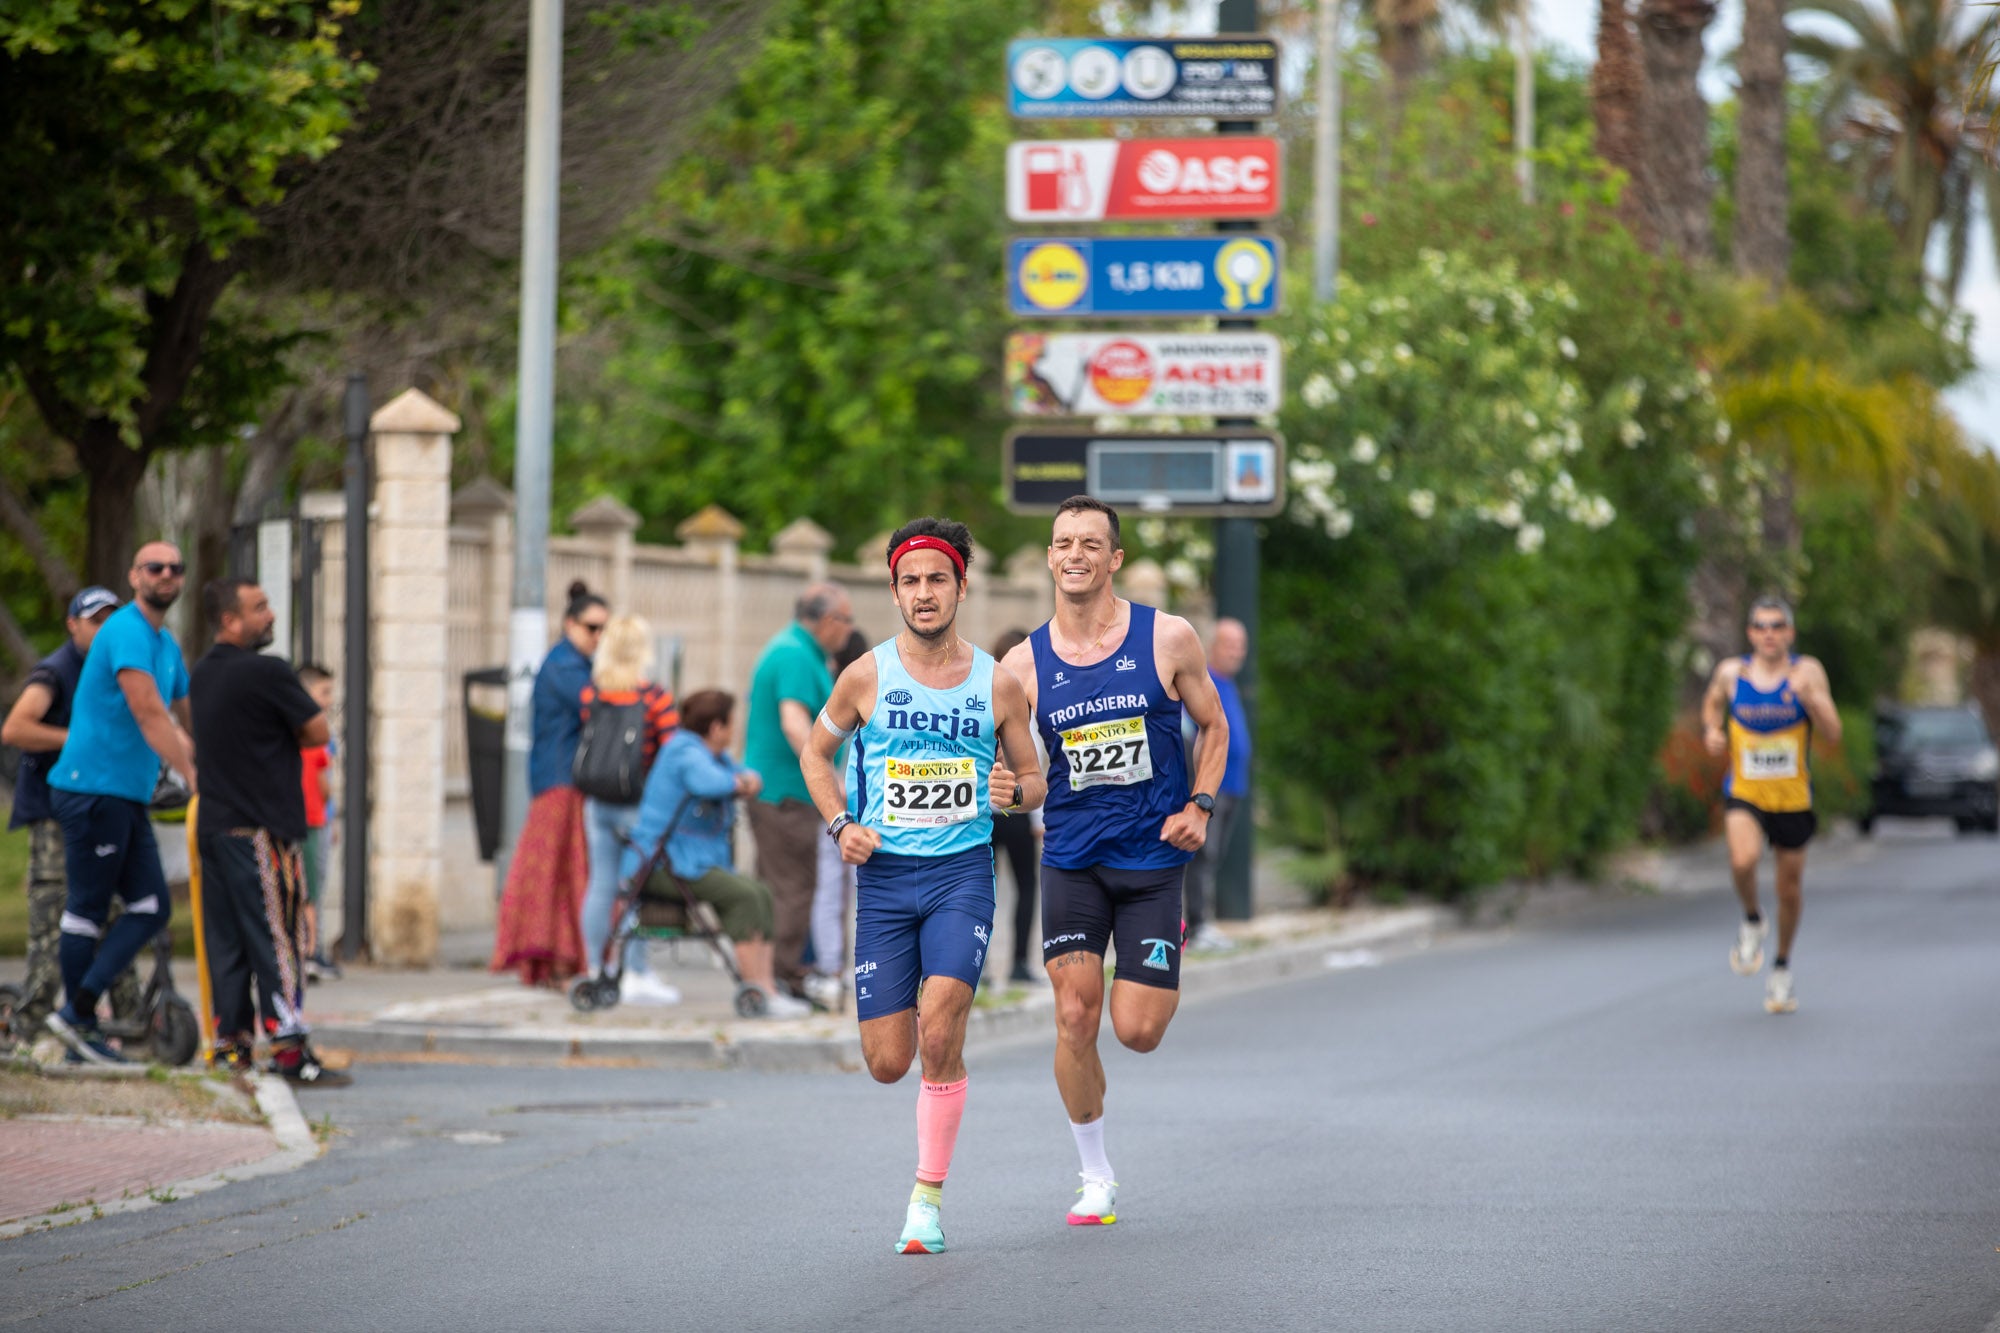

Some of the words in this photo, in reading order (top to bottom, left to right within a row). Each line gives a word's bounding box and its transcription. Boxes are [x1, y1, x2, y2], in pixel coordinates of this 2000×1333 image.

[1153, 260, 1204, 291] KM
[887, 691, 912, 703] TROPS
[1048, 693, 1149, 726] TROTASIERRA
[886, 708, 981, 741] nerja
[1072, 731, 1084, 742] 38
[901, 740, 966, 754] ATLETISMO
[1068, 740, 1144, 774] 3227
[897, 763, 911, 775] 38
[911, 767, 958, 776] FONDO
[887, 782, 973, 810] 3220
